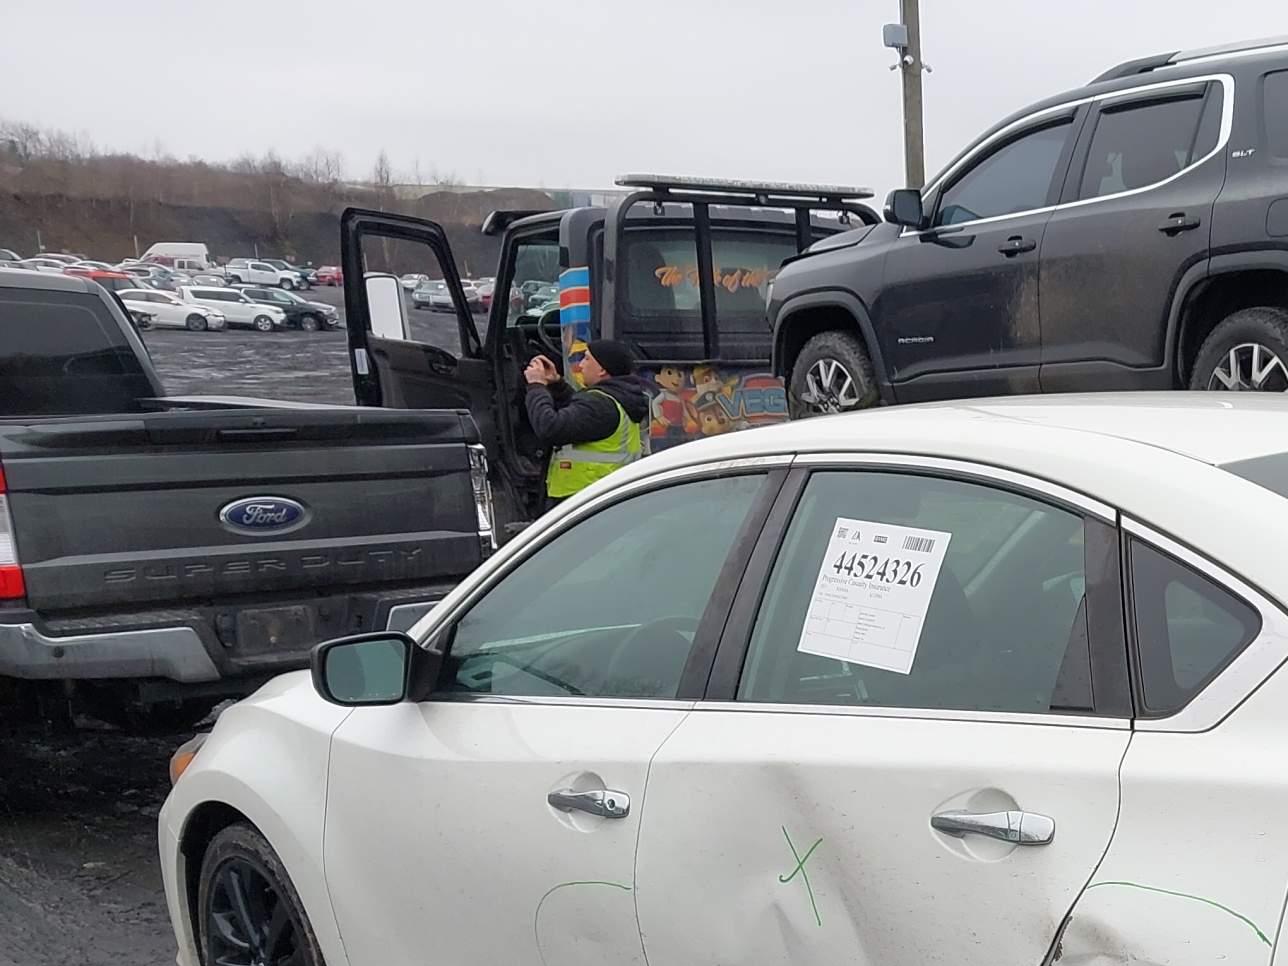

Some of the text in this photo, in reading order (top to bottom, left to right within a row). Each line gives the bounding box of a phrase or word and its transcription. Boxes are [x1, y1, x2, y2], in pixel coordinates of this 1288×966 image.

[242, 504, 288, 525] Ford
[103, 547, 422, 584] SUPER DUTY
[833, 550, 926, 588] 44524326
